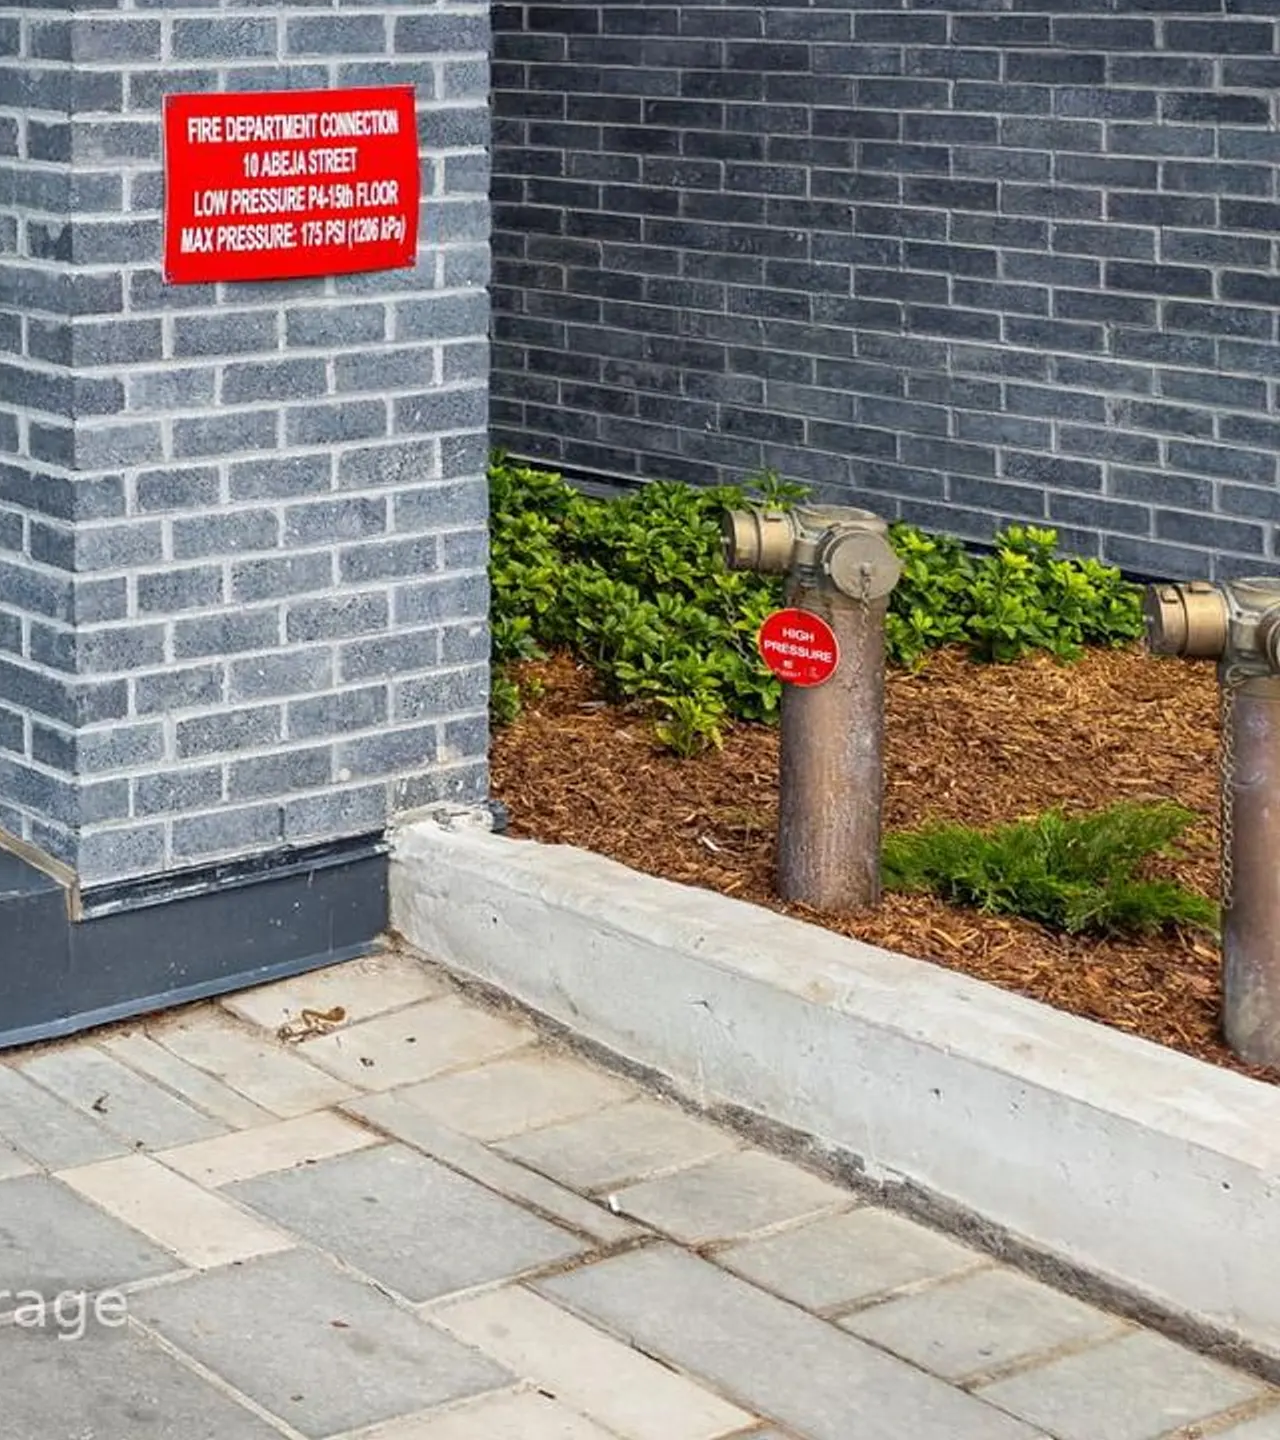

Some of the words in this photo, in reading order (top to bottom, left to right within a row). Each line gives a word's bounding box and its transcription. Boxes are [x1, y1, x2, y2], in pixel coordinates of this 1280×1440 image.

[188, 116, 223, 144] FIRE
[225, 114, 317, 142] DEPARTMENT
[319, 109, 399, 137] CONNECTION
[243, 152, 259, 178] 10
[261, 150, 307, 177] ABEJA
[308, 147, 358, 174] STREET
[194, 190, 229, 217] LOW
[230, 185, 305, 215] PRESSURE
[356, 179, 399, 208] FLOOR
[180, 227, 214, 254] MAX
[216, 221, 298, 252] PRESSURE:
[300, 220, 323, 248] 175
[325, 218, 346, 246] PSI
[380, 213, 406, 245] kPa)
[763, 639, 833, 663] PRESSURE
[782, 627, 815, 643] HIGH
